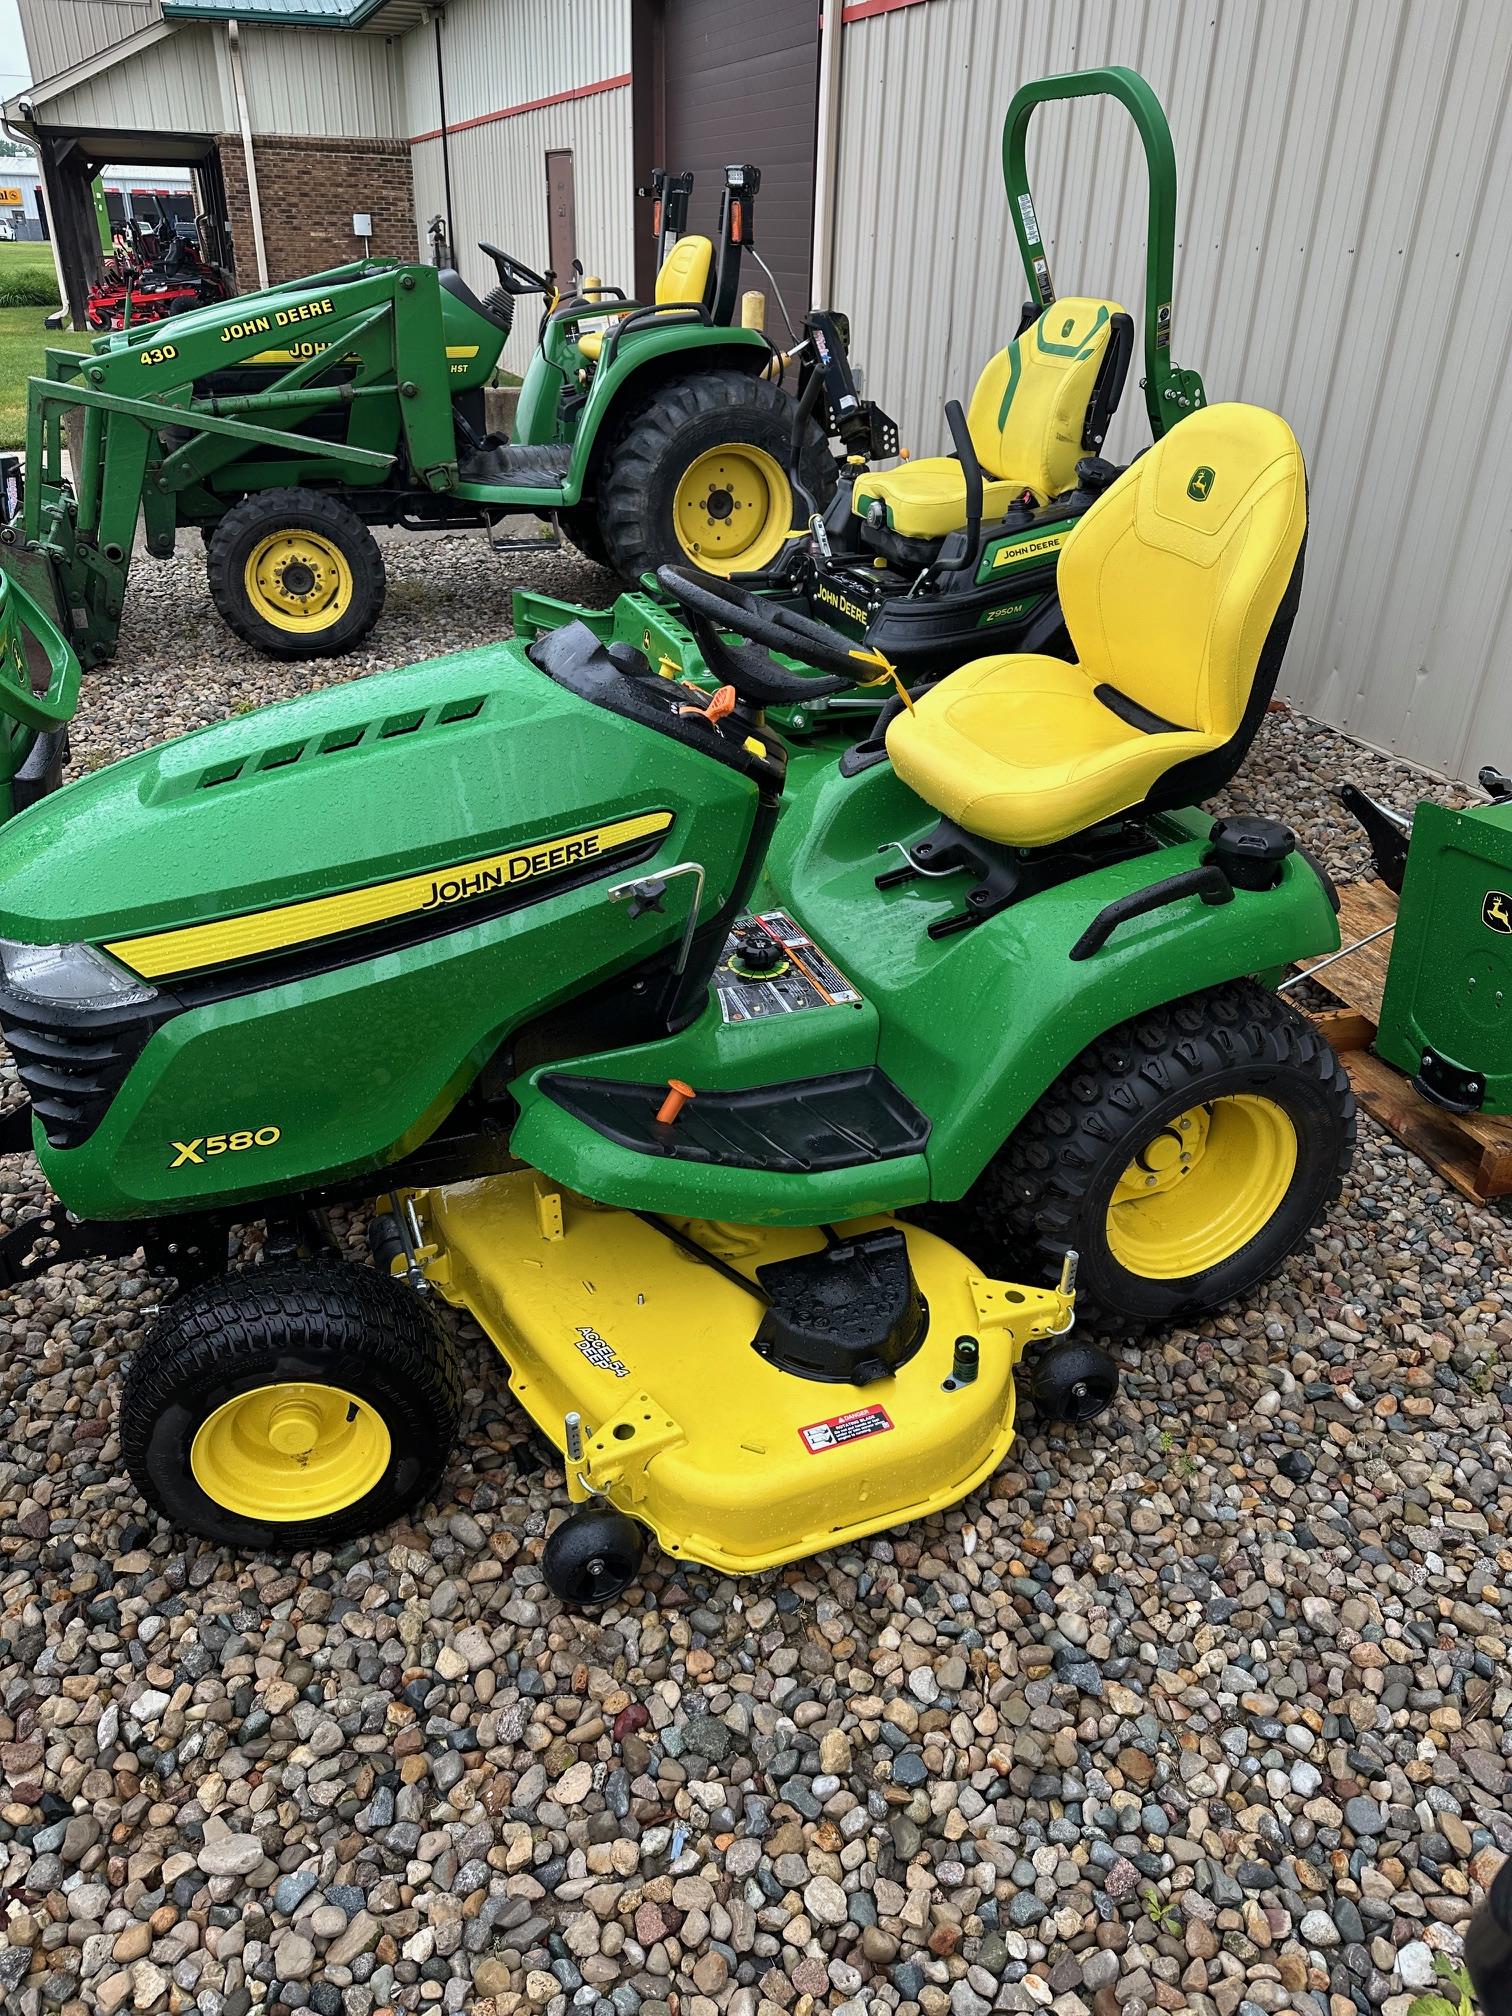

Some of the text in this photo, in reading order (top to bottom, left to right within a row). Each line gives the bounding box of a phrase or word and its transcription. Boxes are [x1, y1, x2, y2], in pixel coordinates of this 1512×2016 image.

[220, 298, 335, 343] JOHN DEERE
[140, 344, 178, 366] 430
[289, 341, 333, 358] JOH
[450, 364, 469, 373] HST
[1003, 538, 1061, 560] JOHN DEERE
[816, 583, 839, 609] JOHN
[839, 595, 868, 626] DEERE
[986, 604, 1023, 622] Z950M
[422, 834, 601, 909] JOHN DEERE
[167, 1125, 282, 1169] X580
[574, 1340, 610, 1369] DEEP
[575, 1327, 630, 1377] ACCEL 54
[844, 1409, 870, 1421] DANGER
